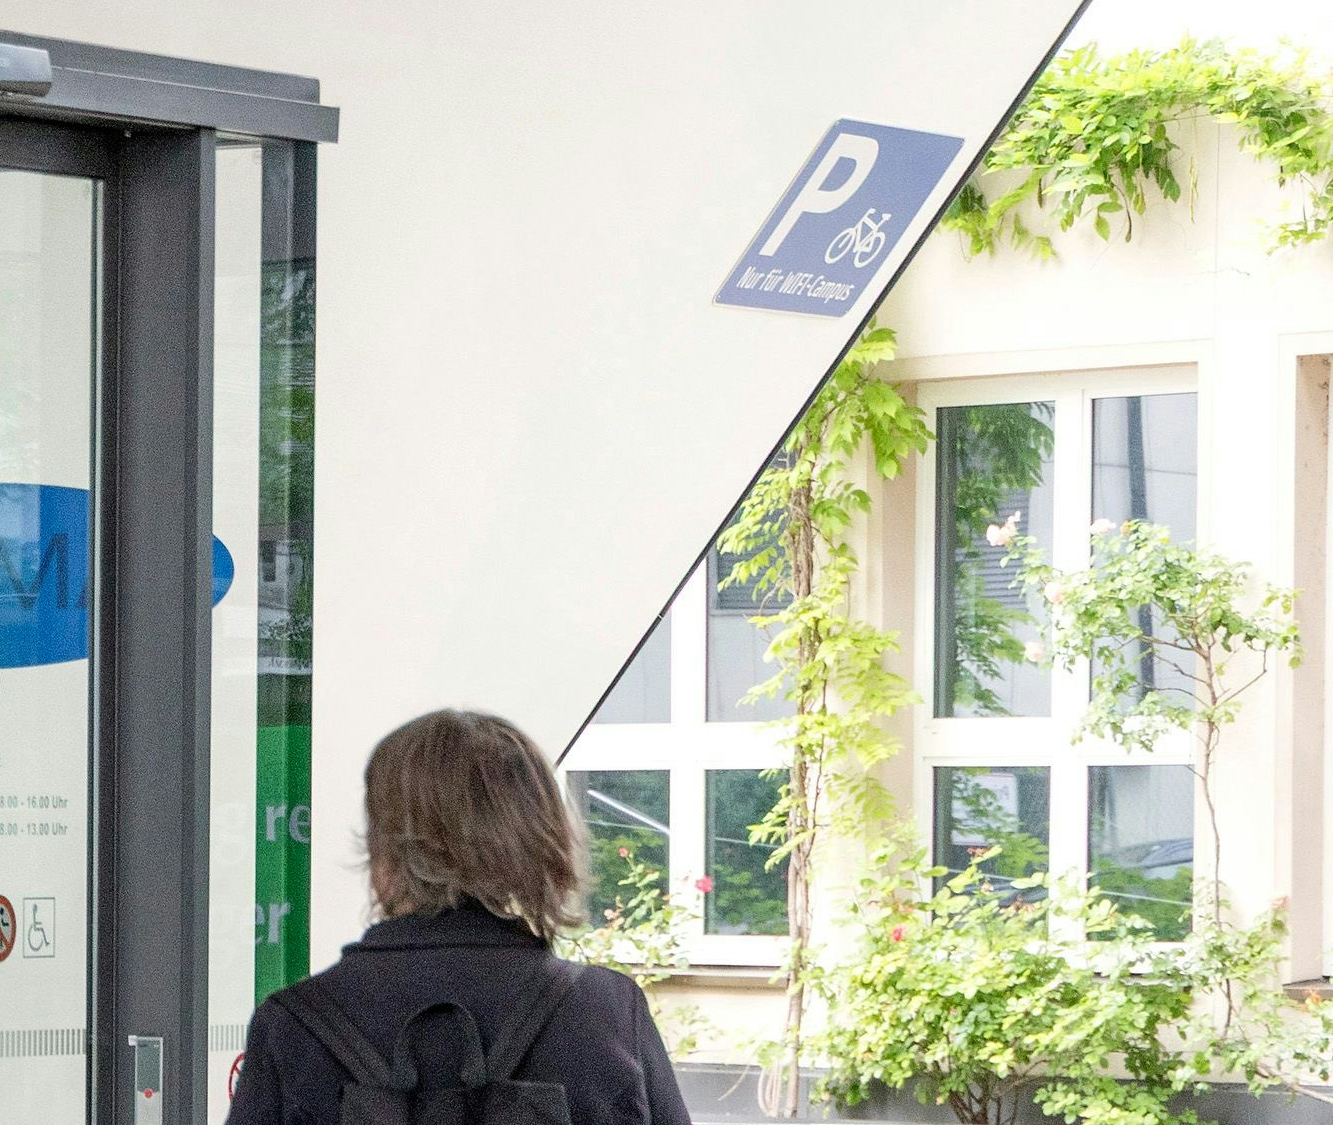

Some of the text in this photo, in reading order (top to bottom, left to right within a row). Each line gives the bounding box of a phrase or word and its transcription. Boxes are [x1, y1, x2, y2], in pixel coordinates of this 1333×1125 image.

[759, 133, 879, 256] P
[737, 266, 854, 302] Nur für WIFI-Campus
[0, 796, 17, 809] 8.00
[27, 796, 49, 808] 16.00
[52, 796, 68, 808] Uhr
[0, 824, 68, 835] 8.00 13.00 Uhr
